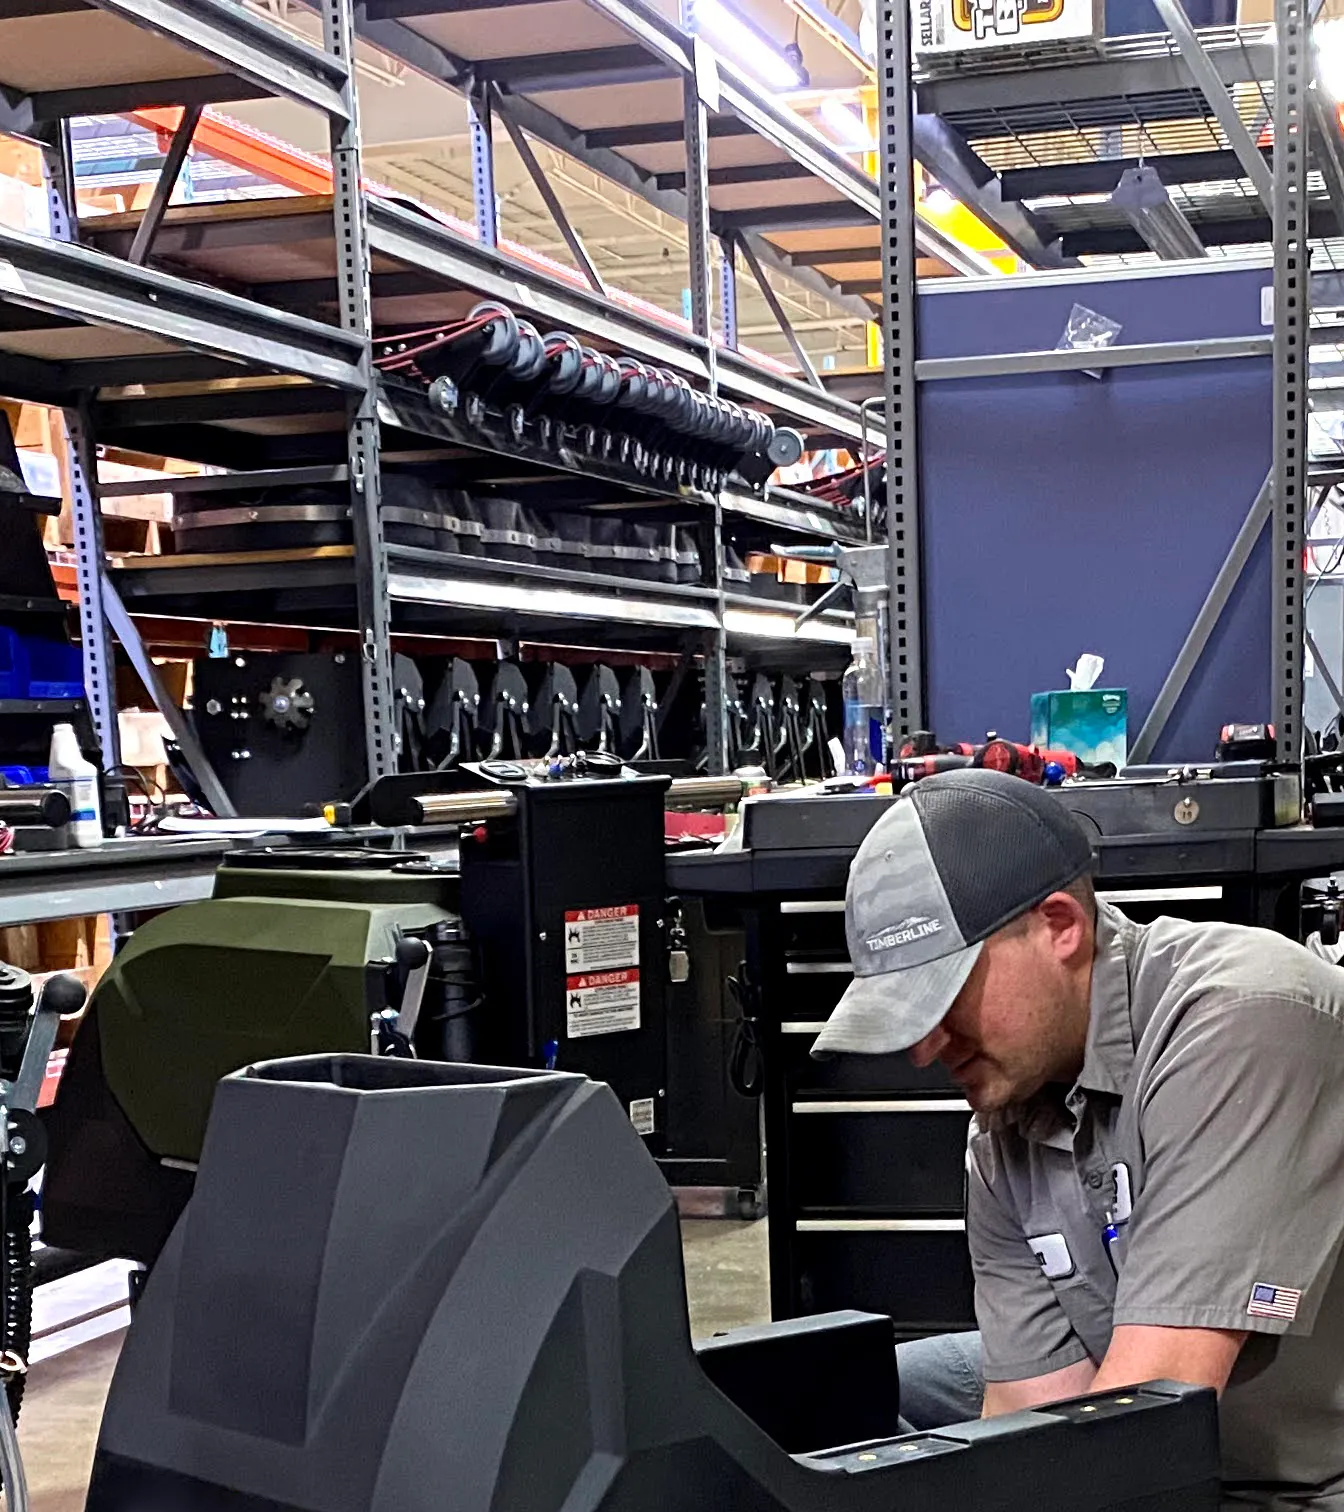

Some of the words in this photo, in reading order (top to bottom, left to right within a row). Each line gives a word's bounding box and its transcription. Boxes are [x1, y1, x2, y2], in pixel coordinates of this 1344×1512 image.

[587, 907, 627, 920] DANGER
[866, 919, 943, 951] TIMBERLINE
[588, 972, 628, 986] DANGER
